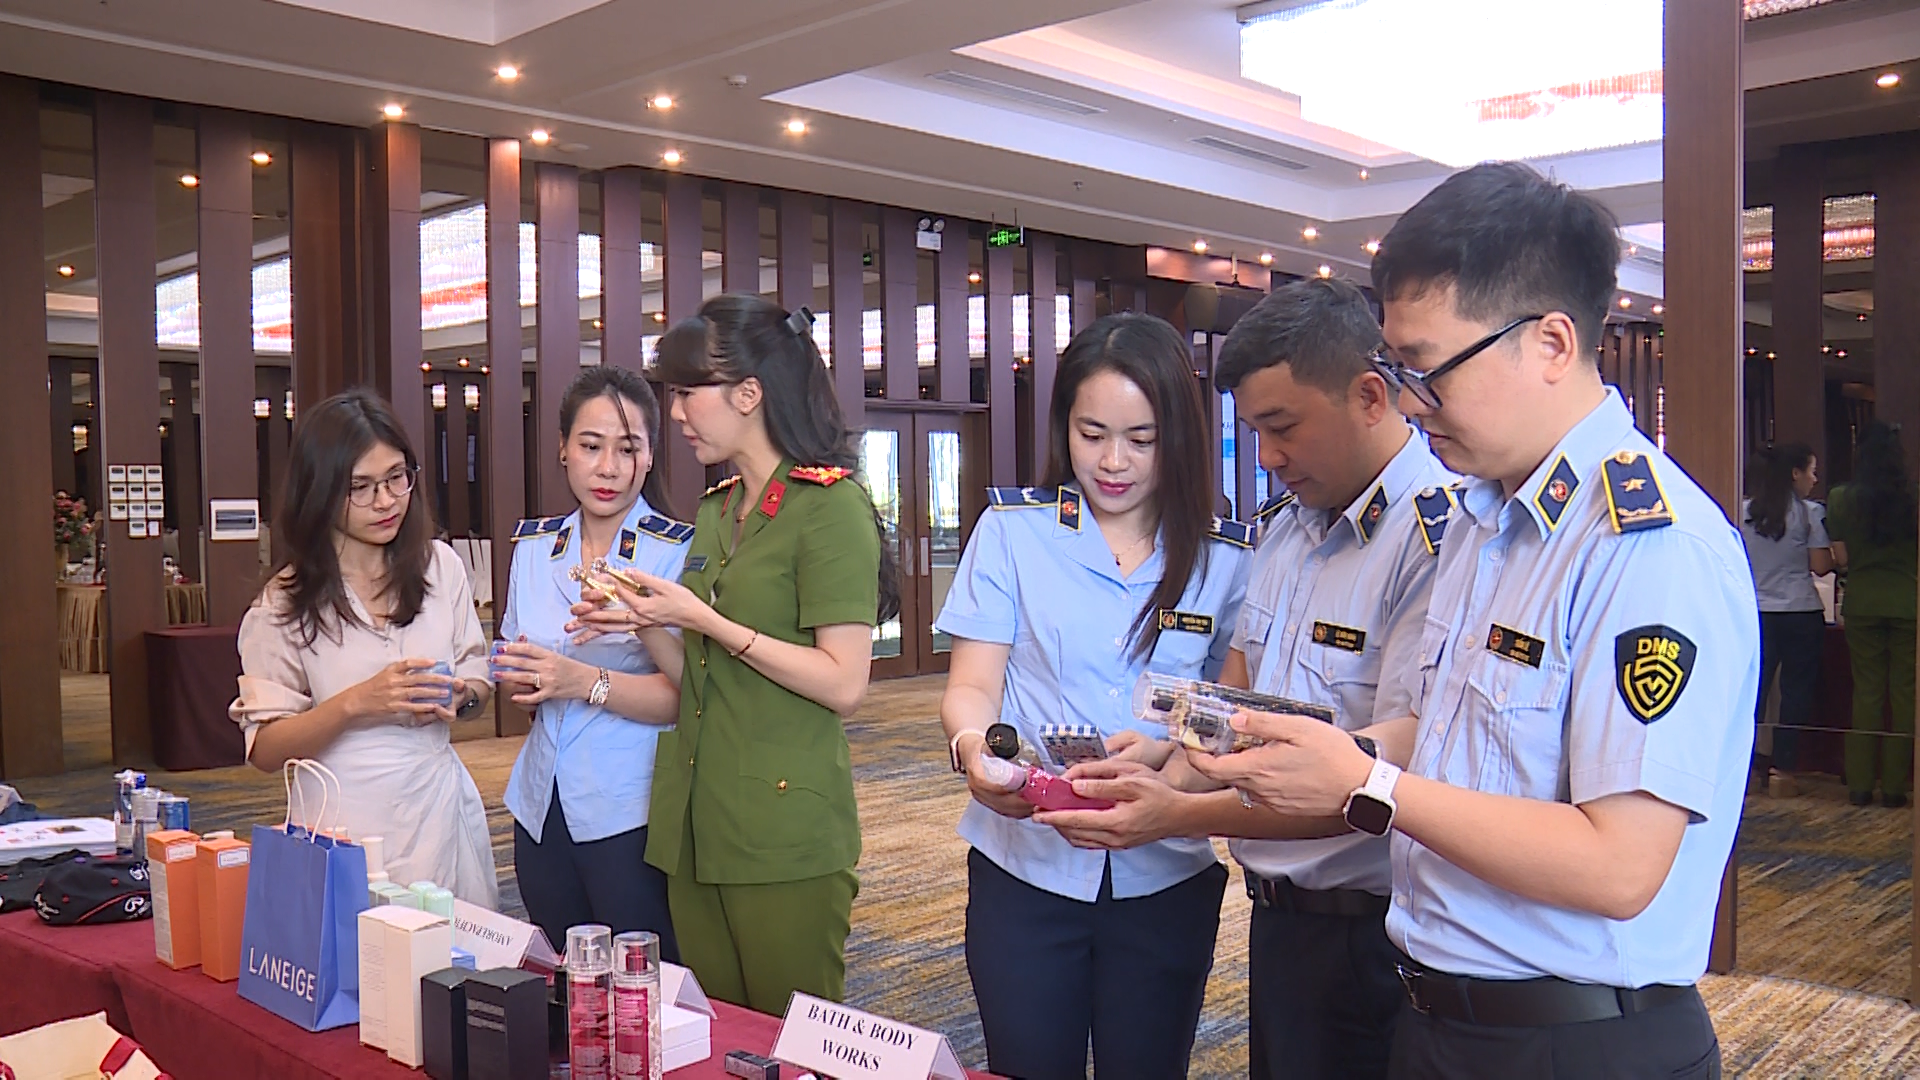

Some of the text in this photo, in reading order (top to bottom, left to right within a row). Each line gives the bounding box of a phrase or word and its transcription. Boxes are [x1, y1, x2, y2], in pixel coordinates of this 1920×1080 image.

[1637, 637, 1680, 660] DMS
[249, 947, 316, 1002] LANEIGE
[808, 1004, 919, 1050] BATH & BODY
[823, 1039, 881, 1071] WORKS
